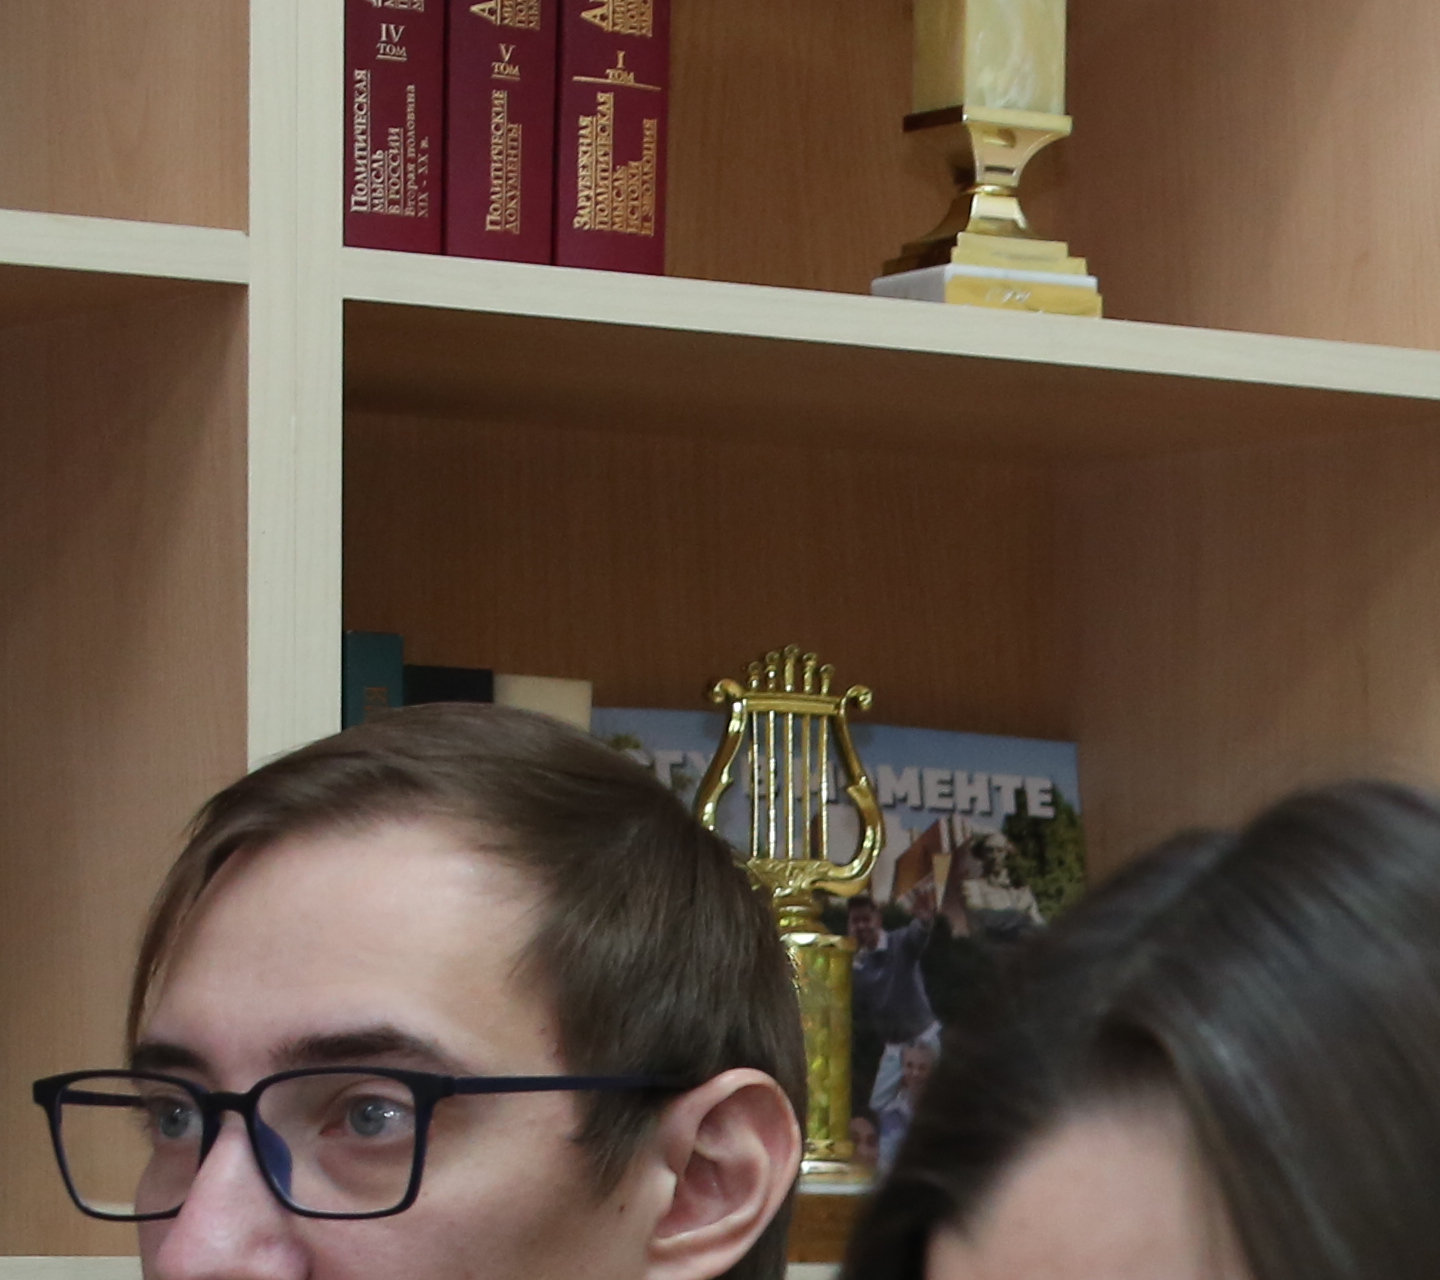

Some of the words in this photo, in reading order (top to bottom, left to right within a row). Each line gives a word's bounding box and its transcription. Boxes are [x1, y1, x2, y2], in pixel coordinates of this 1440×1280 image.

[375, 42, 408, 58] ТОМ
[379, 22, 406, 43] IV
[498, 42, 517, 63] V
[615, 49, 626, 69] I
[490, 60, 522, 77] ТОМ
[604, 68, 636, 85] ТОМ
[405, 83, 416, 159] половина
[370, 148, 386, 213] МЫСЛЬ
[387, 126, 401, 199] РОССИИ
[404, 161, 419, 217] Вторая
[504, 122, 520, 235] ДОКУМЕНТЫ
[572, 114, 594, 231] ЗАРУБЕЖНАЯ
[595, 91, 612, 231] ПОЛИТИЧЕСКАЯ
[641, 117, 657, 217] ЭВОЛЮЦИЯ
[387, 203, 401, 215] В
[626, 159, 641, 234] ИСТОКИ
